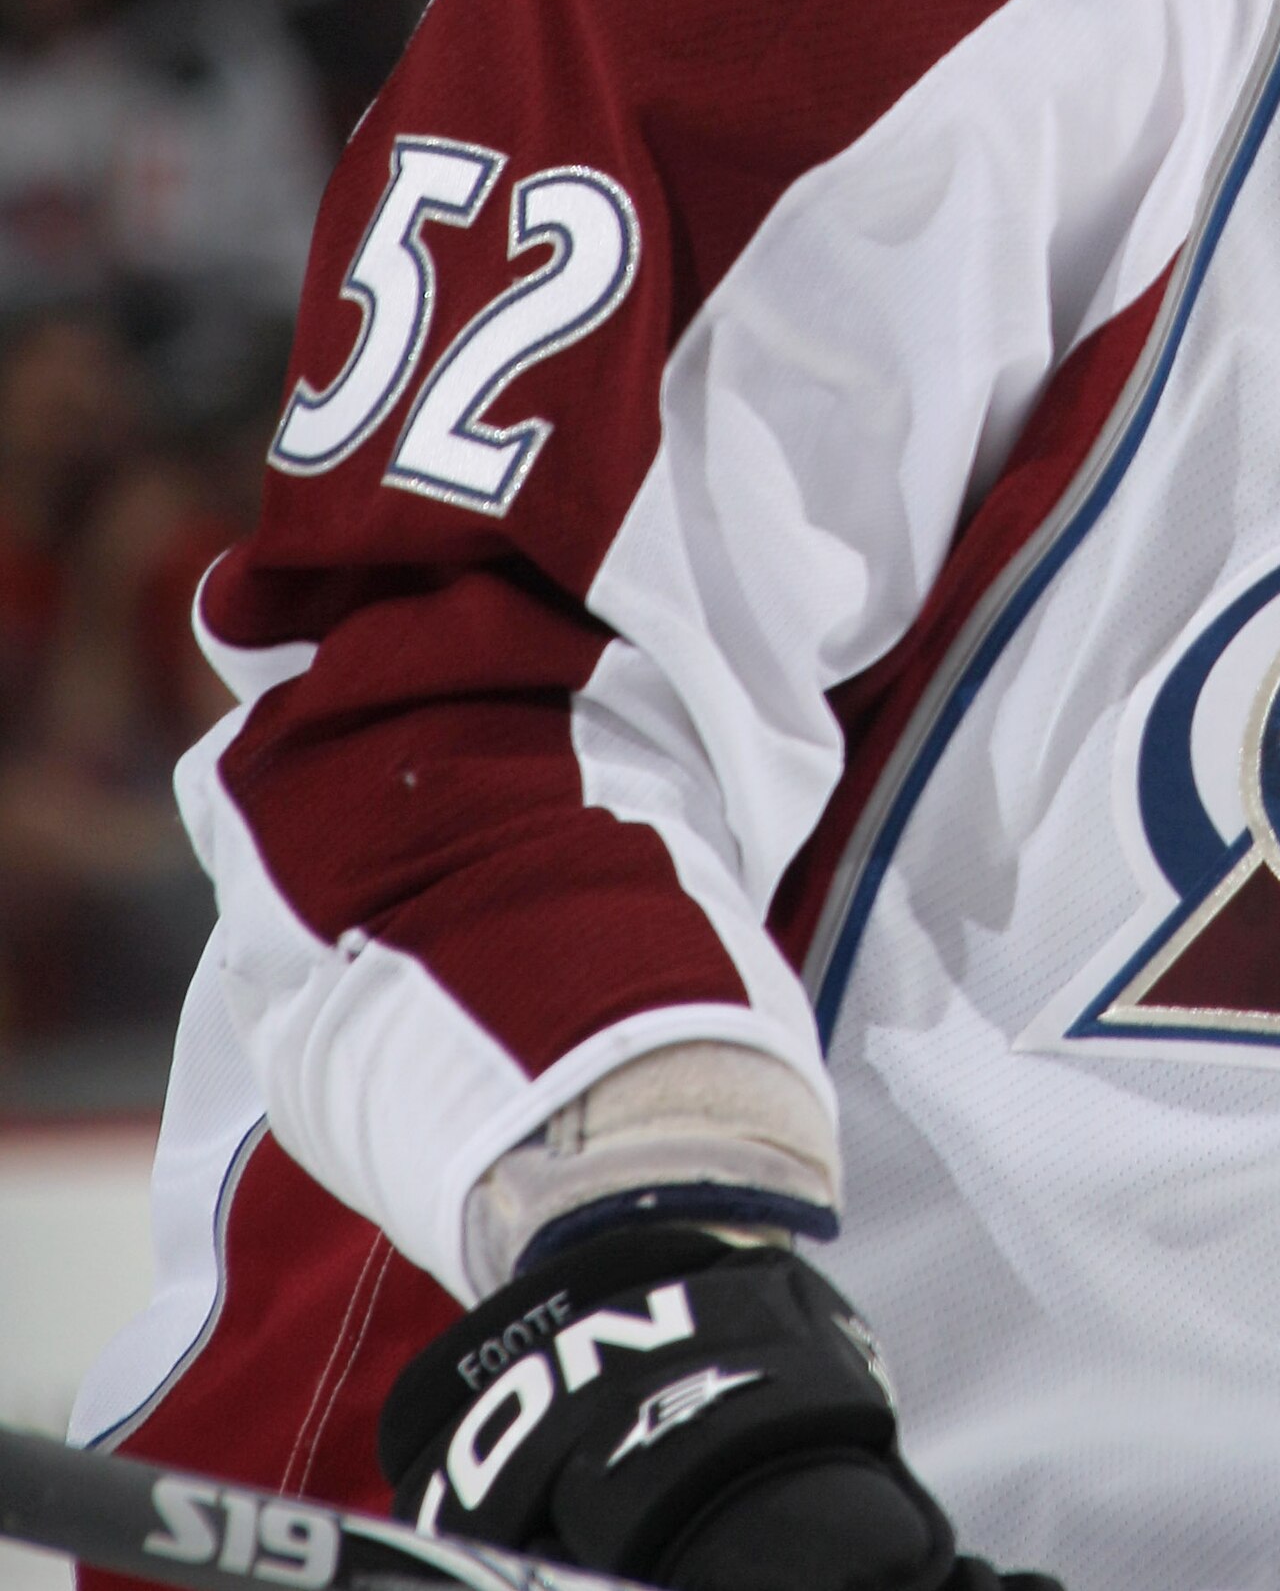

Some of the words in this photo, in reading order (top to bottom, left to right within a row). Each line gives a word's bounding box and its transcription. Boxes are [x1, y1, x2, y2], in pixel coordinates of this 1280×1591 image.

[266, 133, 642, 520] 52
[457, 1289, 571, 1390] FOOTE
[142, 1472, 341, 1590] S19
